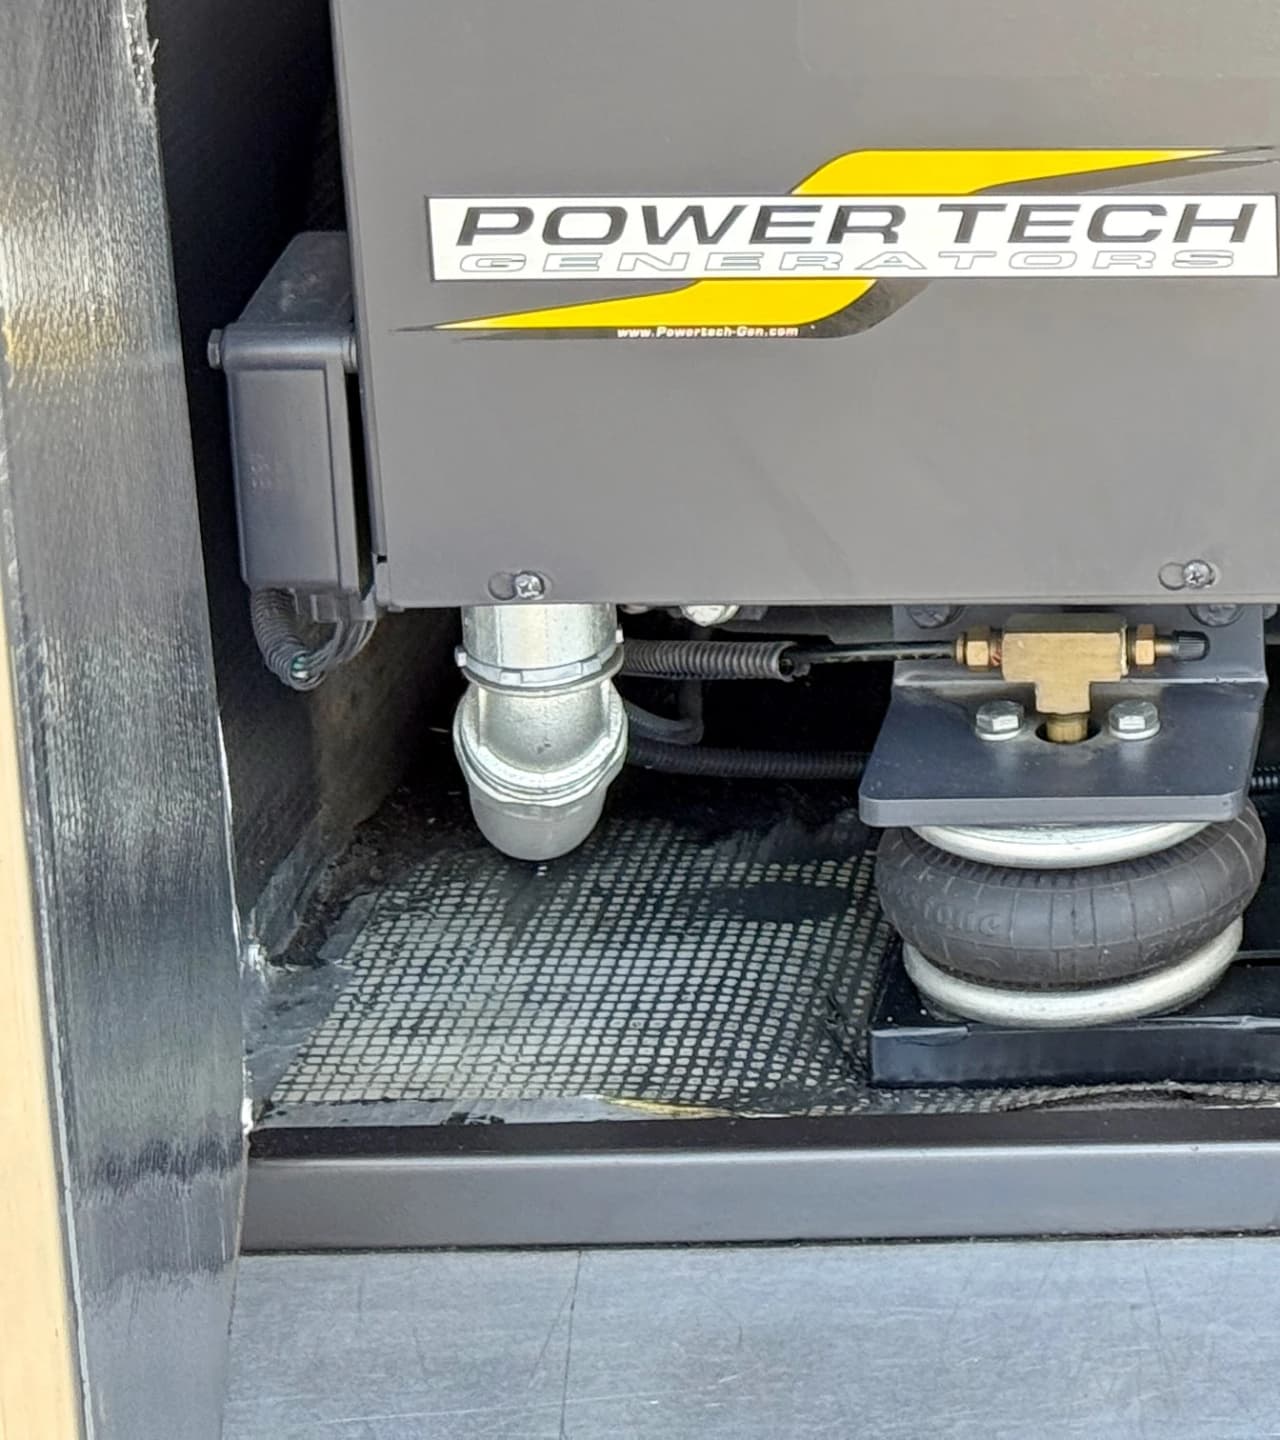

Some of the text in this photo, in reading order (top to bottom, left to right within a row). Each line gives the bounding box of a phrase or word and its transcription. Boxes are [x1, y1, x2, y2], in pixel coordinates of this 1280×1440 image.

[455, 201, 1258, 246] POWER TECH
[458, 247, 1238, 275] GENERATORS
[616, 323, 800, 339] www.Powertech-Gen.com
